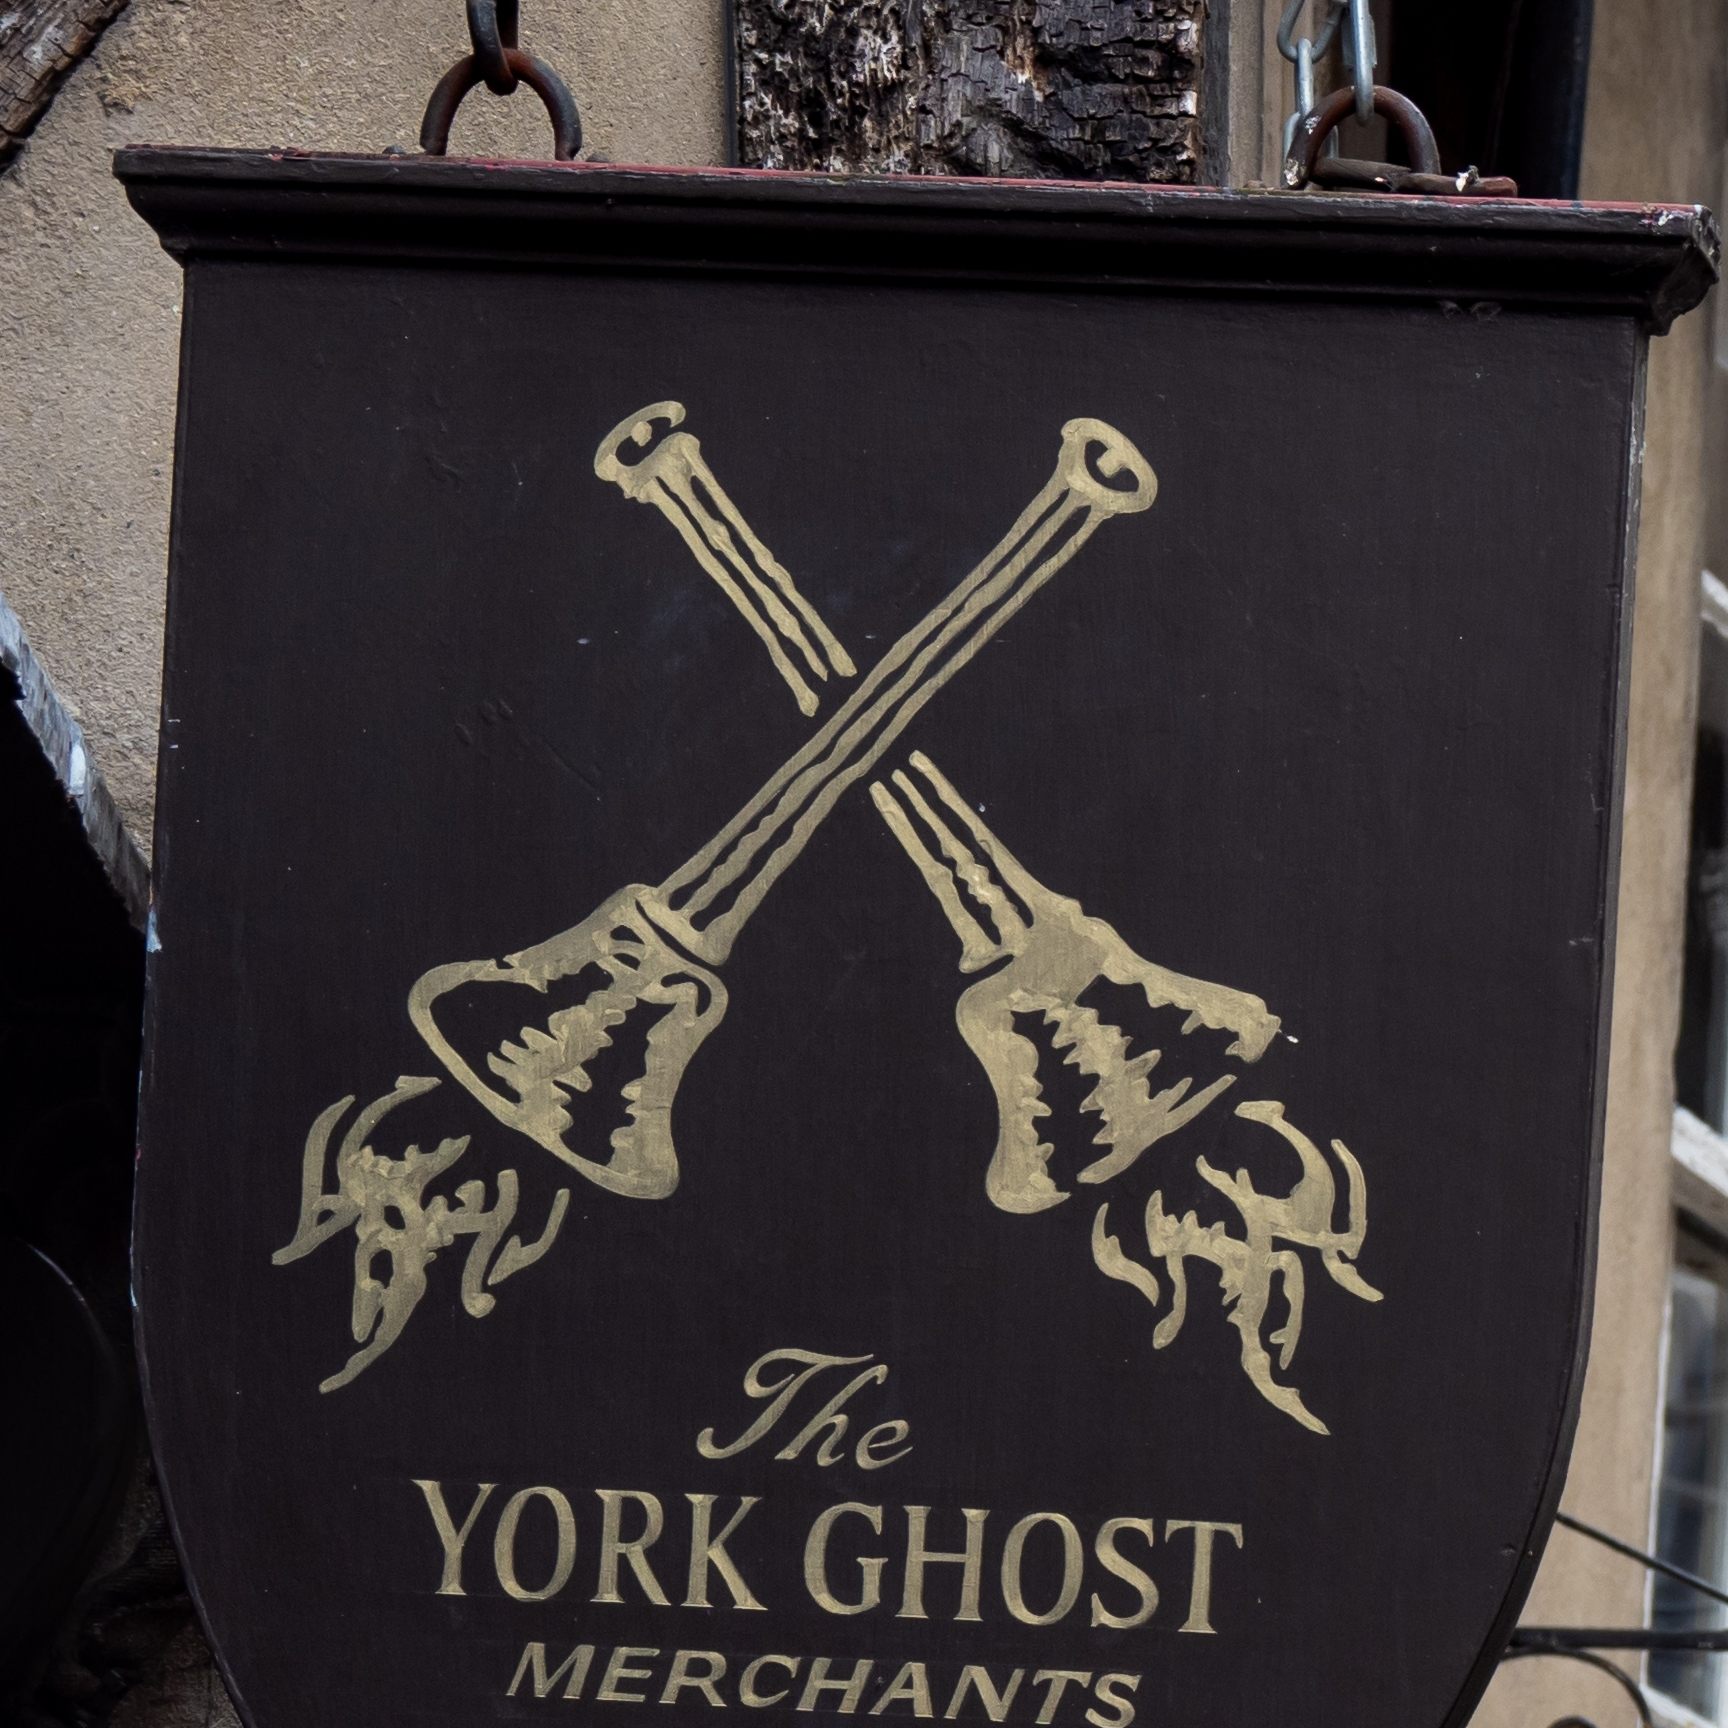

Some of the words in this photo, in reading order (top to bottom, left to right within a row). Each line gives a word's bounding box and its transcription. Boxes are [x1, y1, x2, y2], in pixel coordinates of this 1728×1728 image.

[697, 1347, 912, 1469] The
[413, 1480, 767, 1611] YORK
[804, 1502, 1243, 1633] GHOST
